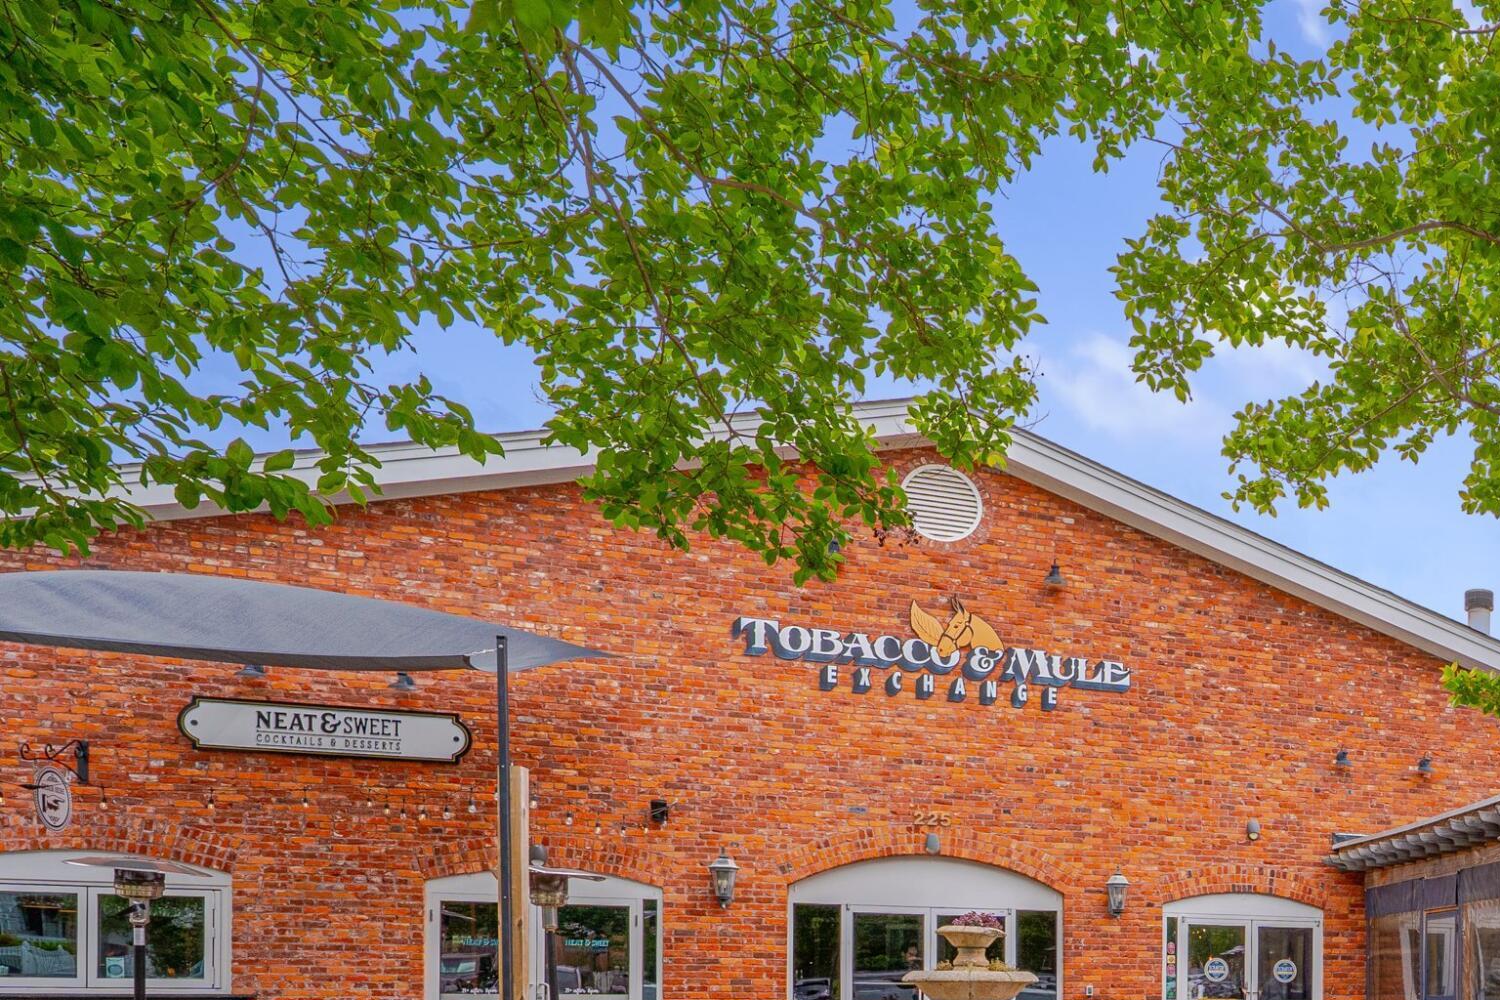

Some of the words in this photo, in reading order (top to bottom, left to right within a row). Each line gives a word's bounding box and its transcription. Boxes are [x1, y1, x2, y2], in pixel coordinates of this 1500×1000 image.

[736, 616, 960, 671] TOBACCO
[970, 646, 1004, 672] &
[1006, 647, 1131, 689] MULE
[822, 667, 1058, 707] EXCHANGE
[256, 710, 318, 732] NEAT
[343, 716, 402, 737] SWEET
[256, 733, 323, 747] COCKTAILS
[330, 738, 337, 748] &
[344, 738, 402, 751] DESSERTS
